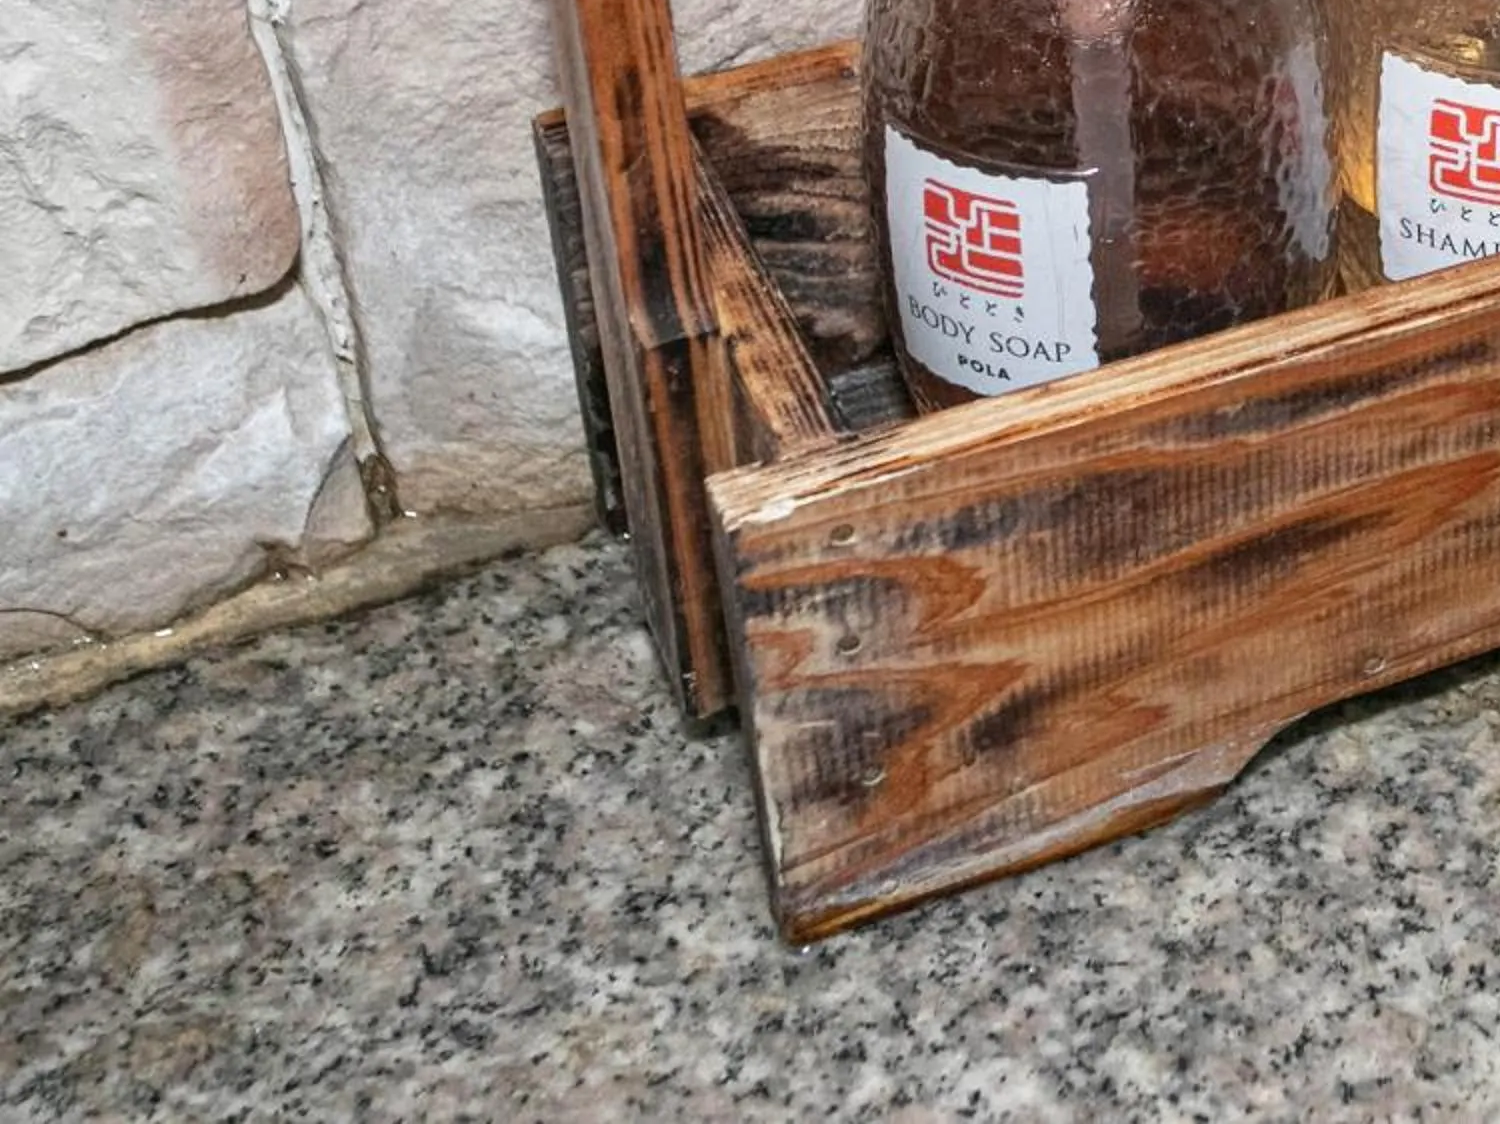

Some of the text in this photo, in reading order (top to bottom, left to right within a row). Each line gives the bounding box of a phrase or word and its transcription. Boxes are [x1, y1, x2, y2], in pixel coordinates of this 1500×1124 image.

[931, 280, 1025, 324] ひととき
[907, 294, 1071, 363] BODY SOAP
[957, 353, 1012, 381] POLA
